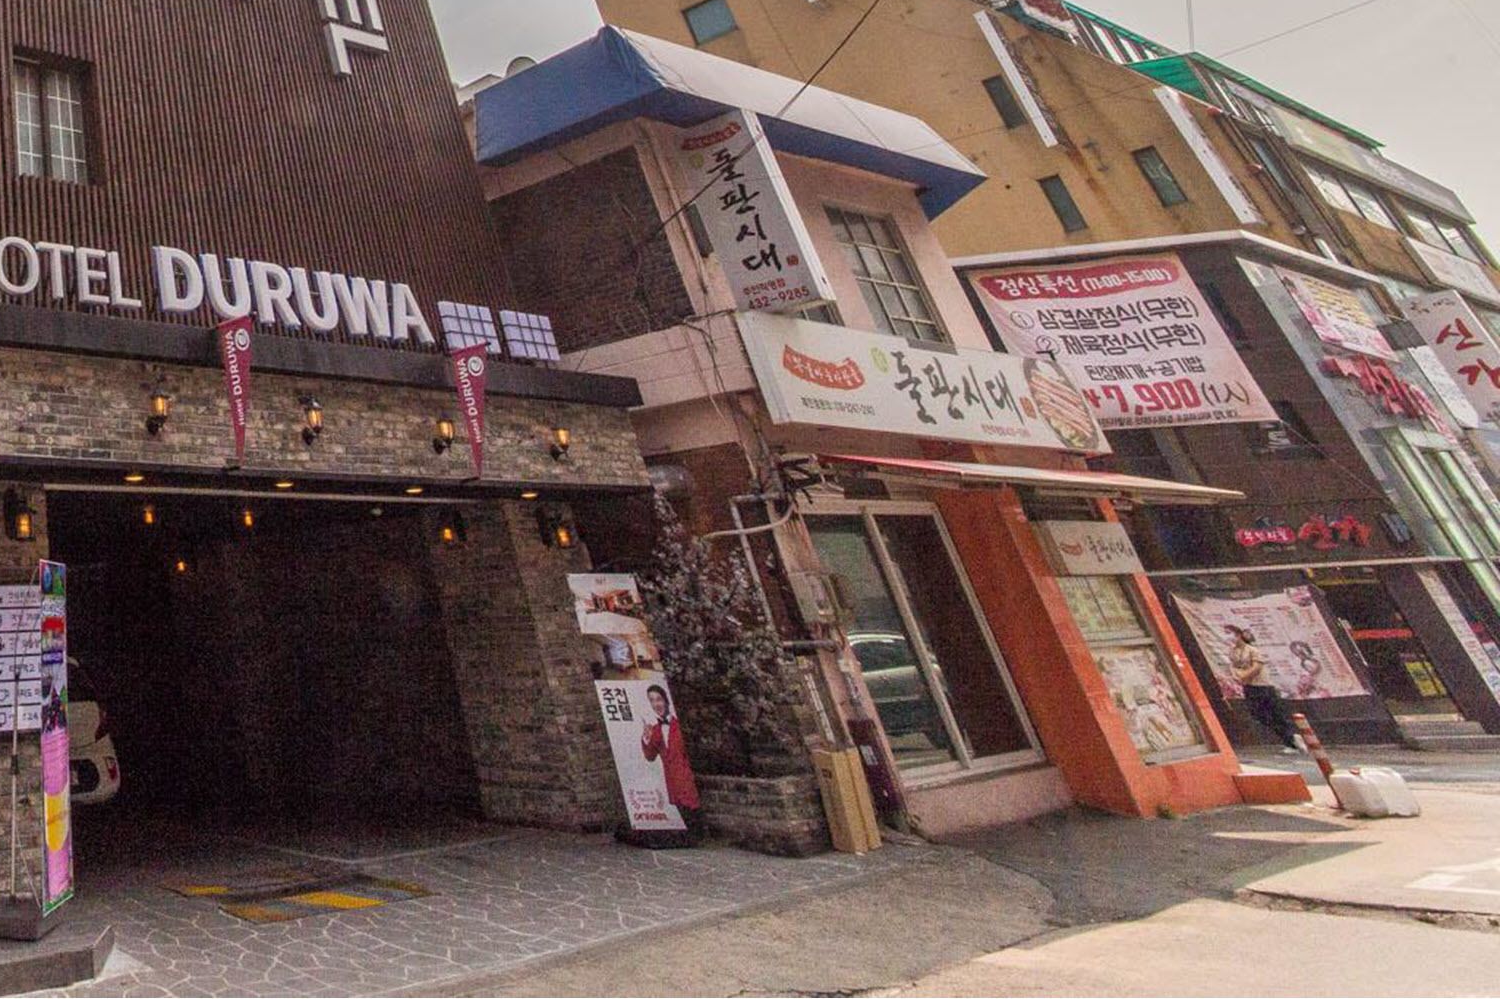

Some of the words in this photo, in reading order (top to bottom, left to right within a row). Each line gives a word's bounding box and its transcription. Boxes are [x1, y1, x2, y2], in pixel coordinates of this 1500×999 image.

[706, 149, 783, 273] 돌판시대
[151, 245, 436, 346] DURUWA
[601, 687, 629, 705] 추천
[606, 703, 635, 722] 모텔
